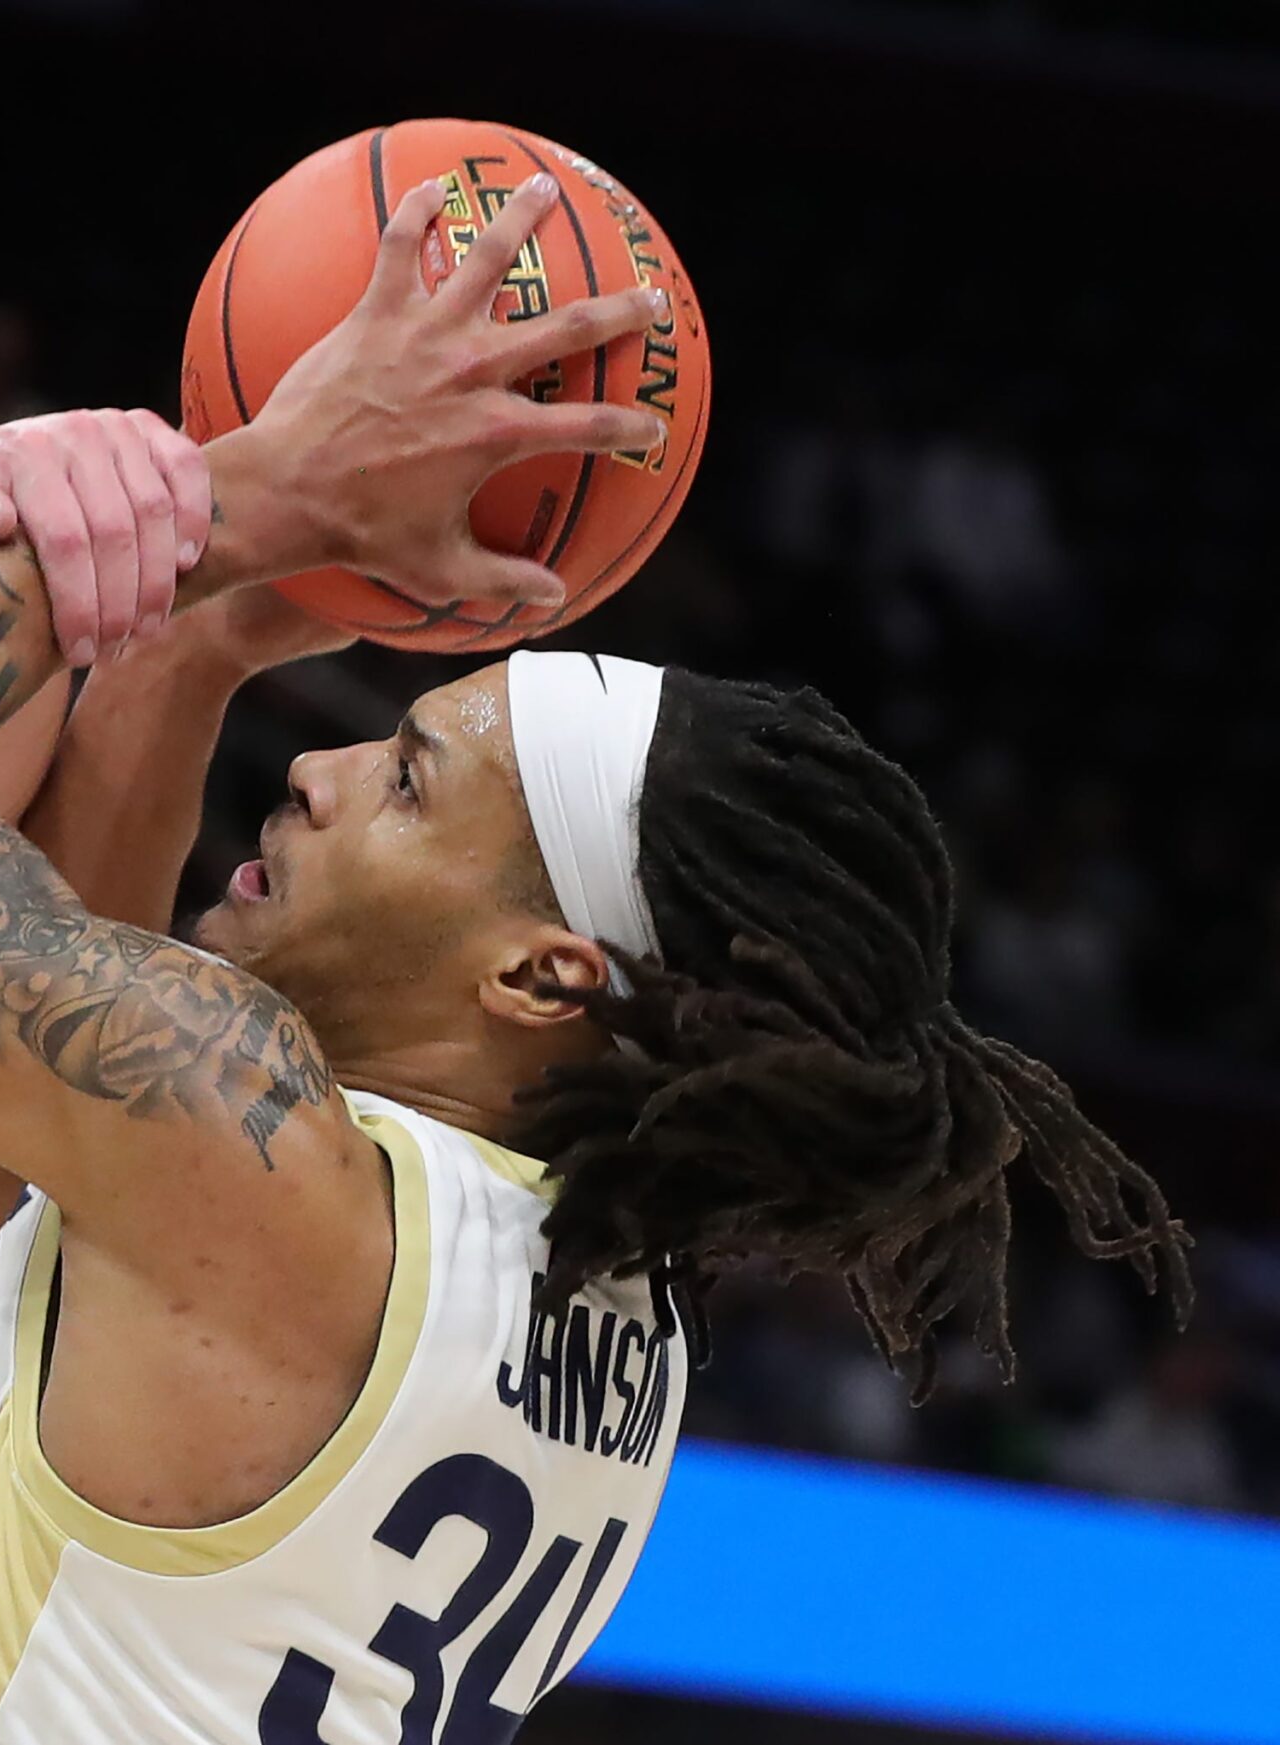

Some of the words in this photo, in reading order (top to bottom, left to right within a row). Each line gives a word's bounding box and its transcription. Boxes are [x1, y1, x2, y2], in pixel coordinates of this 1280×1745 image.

[572, 158, 678, 475] ALDIN
[496, 1271, 670, 1468] JHNSON
[258, 1453, 628, 1745] 34
